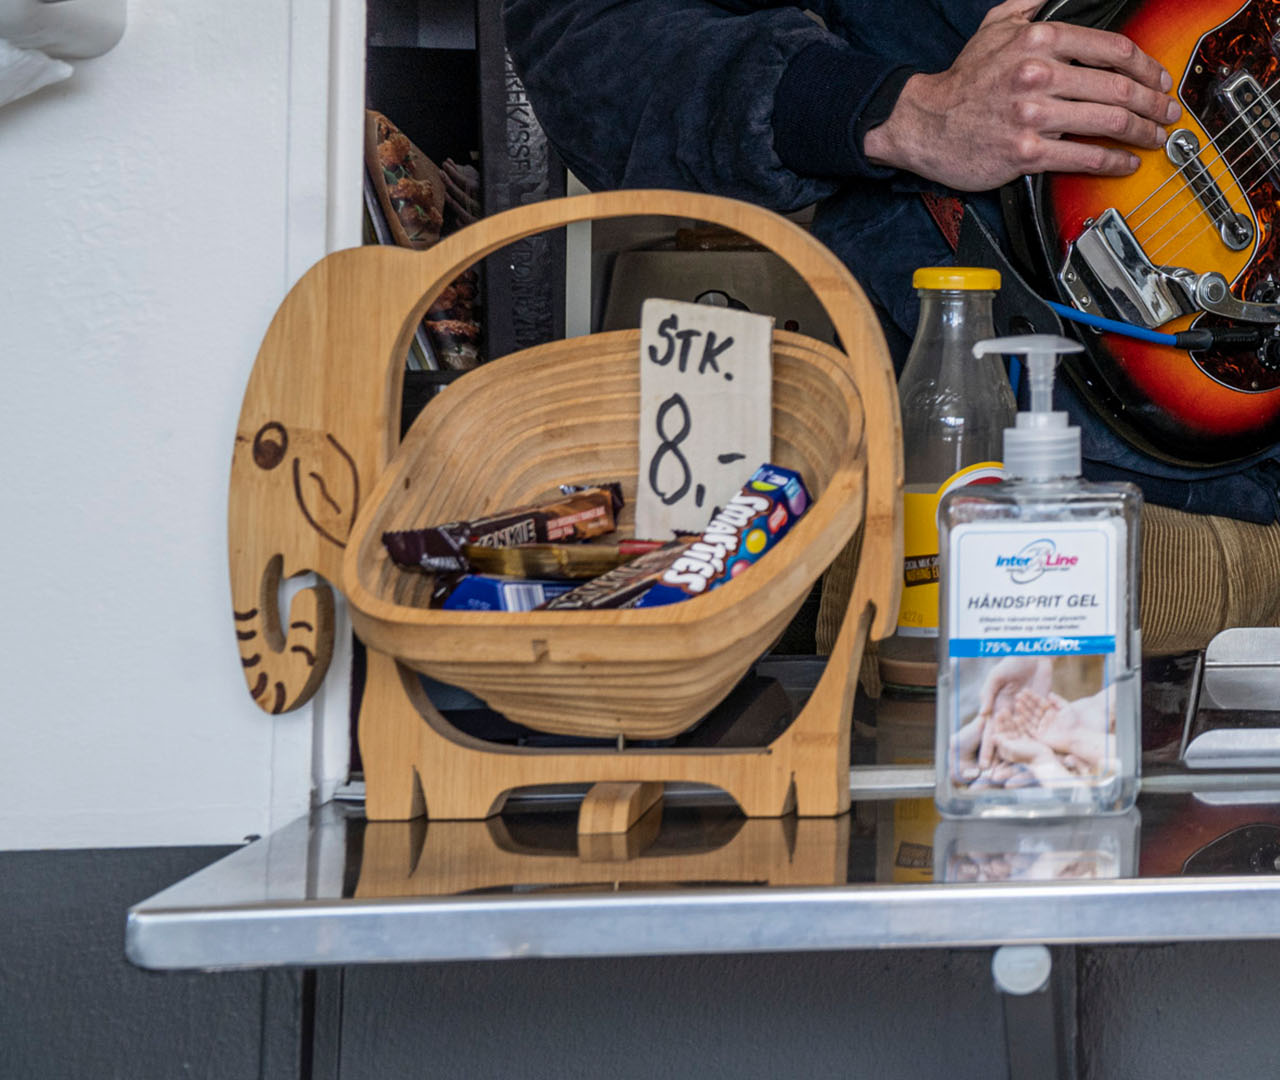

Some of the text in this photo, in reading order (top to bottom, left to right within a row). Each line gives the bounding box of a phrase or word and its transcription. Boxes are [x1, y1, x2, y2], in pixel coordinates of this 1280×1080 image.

[648, 314, 734, 381] STK.
[649, 393, 746, 507] 8,-
[995, 553, 1079, 568] Inter Line
[968, 593, 1099, 609] HÅNDSPRIT GEL
[1014, 638, 1082, 652] ALKOHOL
